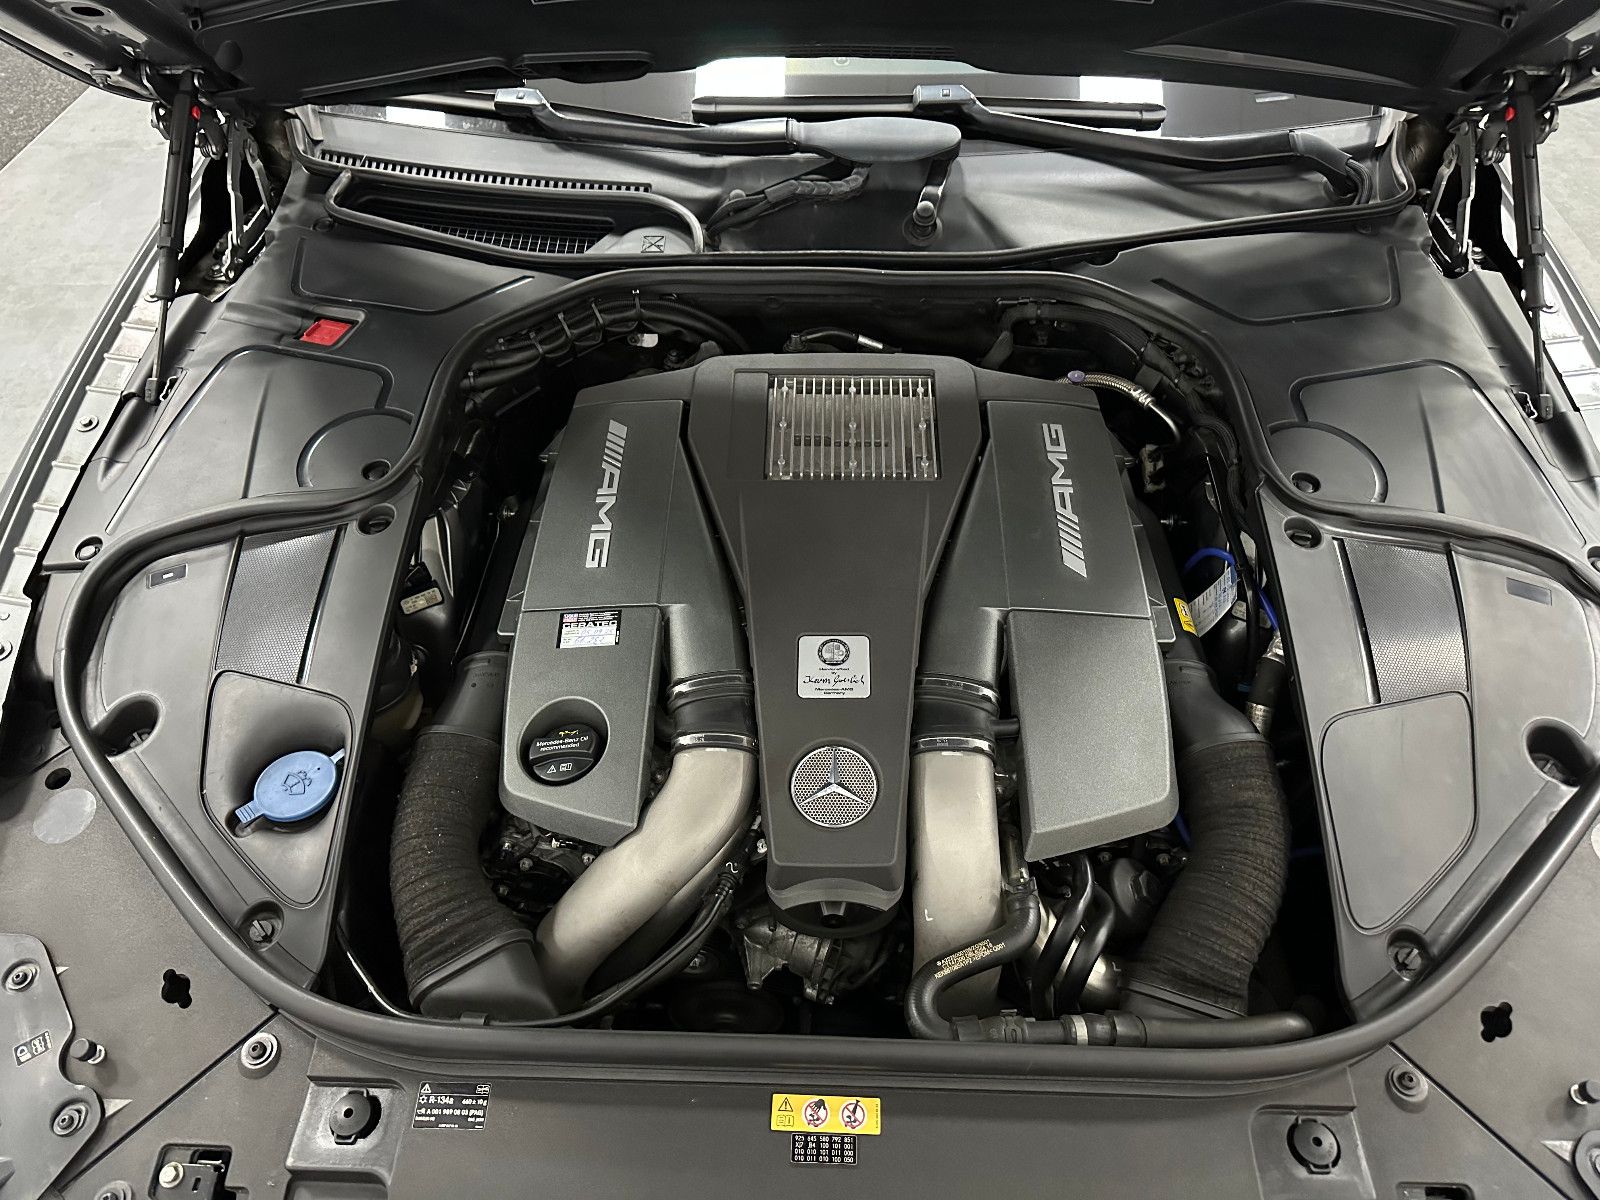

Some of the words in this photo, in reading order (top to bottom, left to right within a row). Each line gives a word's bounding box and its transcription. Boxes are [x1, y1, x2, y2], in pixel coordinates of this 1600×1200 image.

[536, 738, 579, 746] Mercedes-Benz
[540, 742, 580, 751] recommended
[429, 1096, 454, 1104] R-134a
